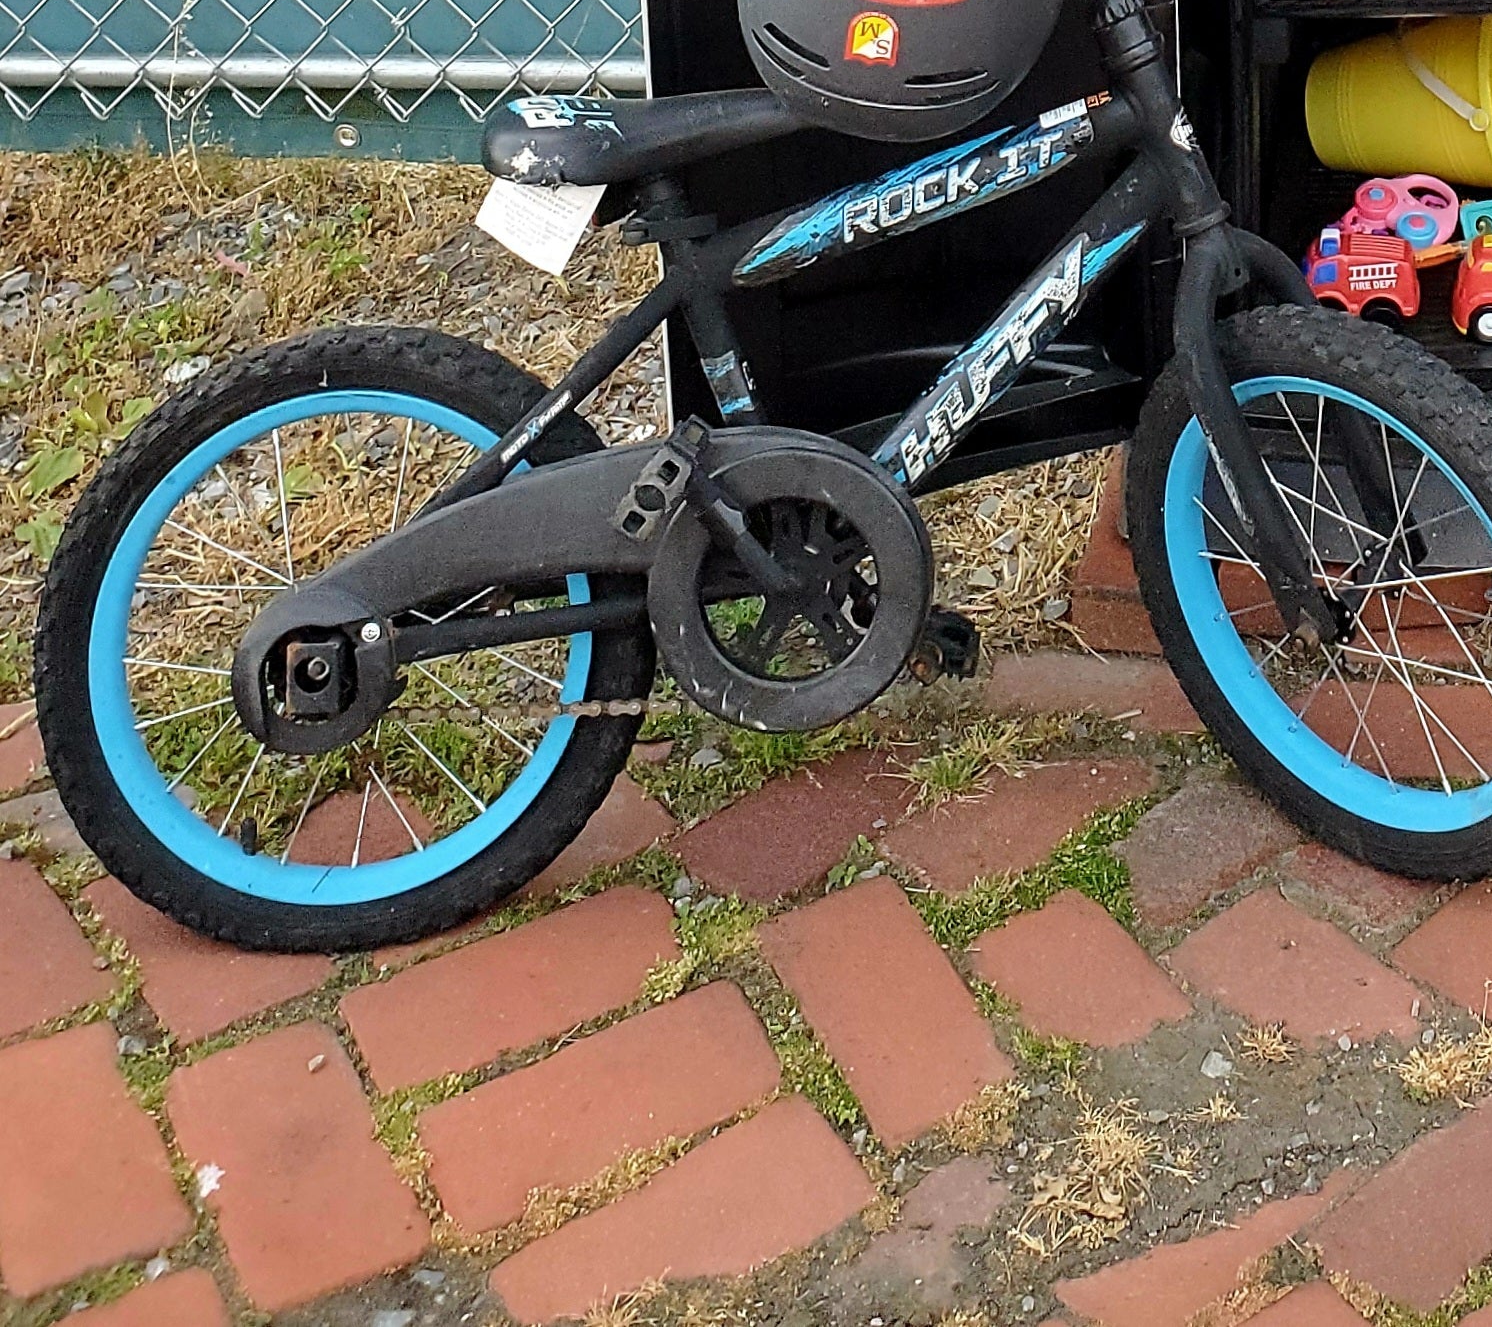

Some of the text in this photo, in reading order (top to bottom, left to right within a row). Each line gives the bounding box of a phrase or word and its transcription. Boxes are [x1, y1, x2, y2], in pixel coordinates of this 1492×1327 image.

[843, 129, 1064, 244] ROCK IT
[1349, 278, 1397, 292] FIRE DEPT
[900, 239, 1083, 484] HUFFY
